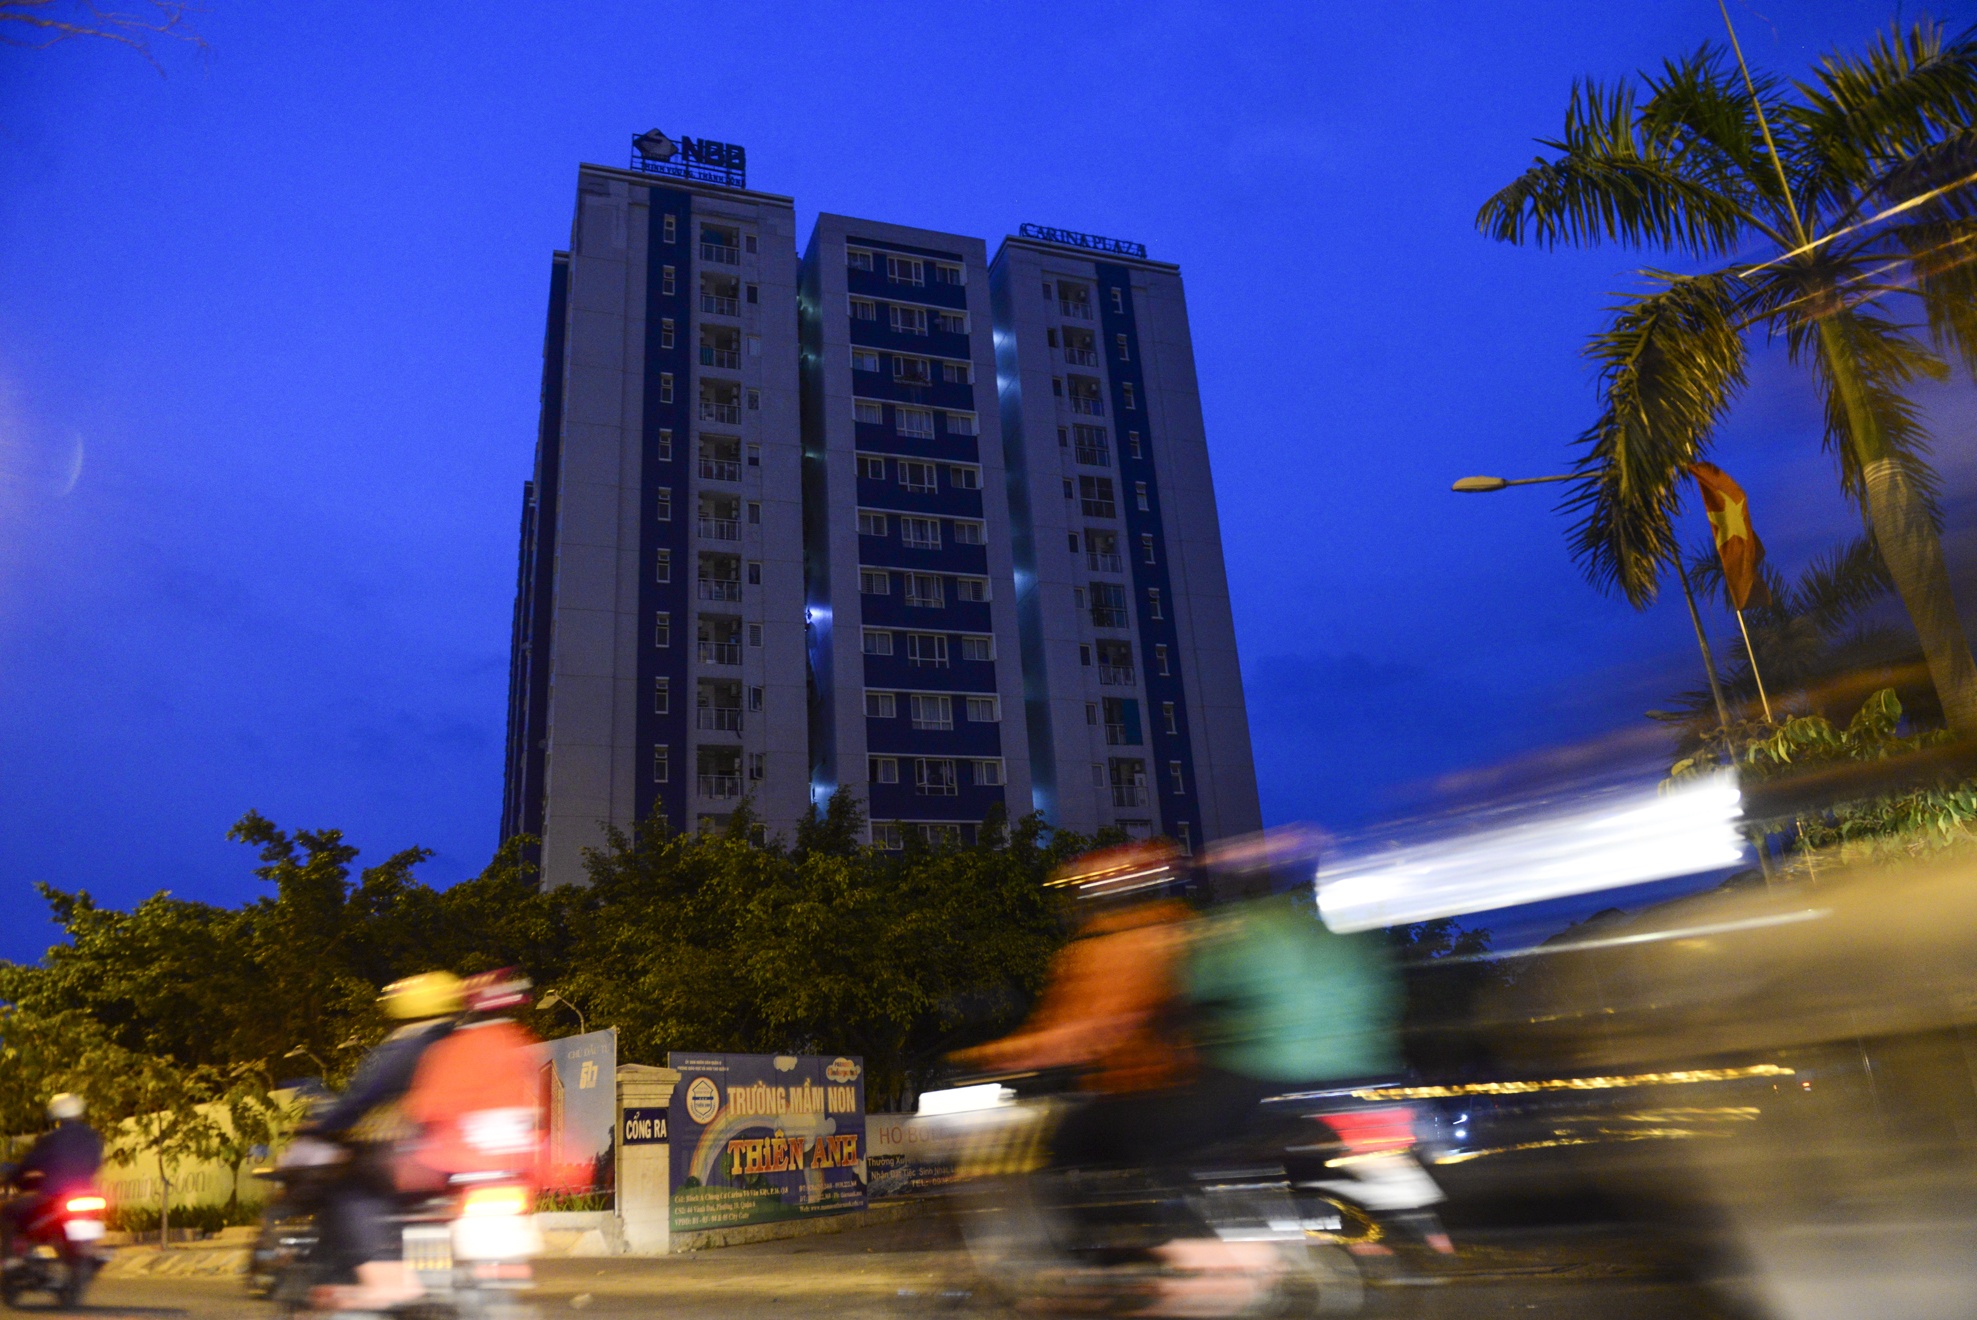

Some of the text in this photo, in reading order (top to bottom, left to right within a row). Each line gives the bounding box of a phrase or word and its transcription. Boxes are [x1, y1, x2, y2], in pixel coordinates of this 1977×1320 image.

[681, 135, 746, 171] NBB
[1022, 222, 1147, 258] CARINA PLAZA
[727, 1079, 787, 1115] TRƯỜNG
[789, 1077, 825, 1114] MẦM
[827, 1086, 856, 1113] NON
[625, 1111, 667, 1140] CỔNG RA
[810, 1134, 858, 1170] ANH
